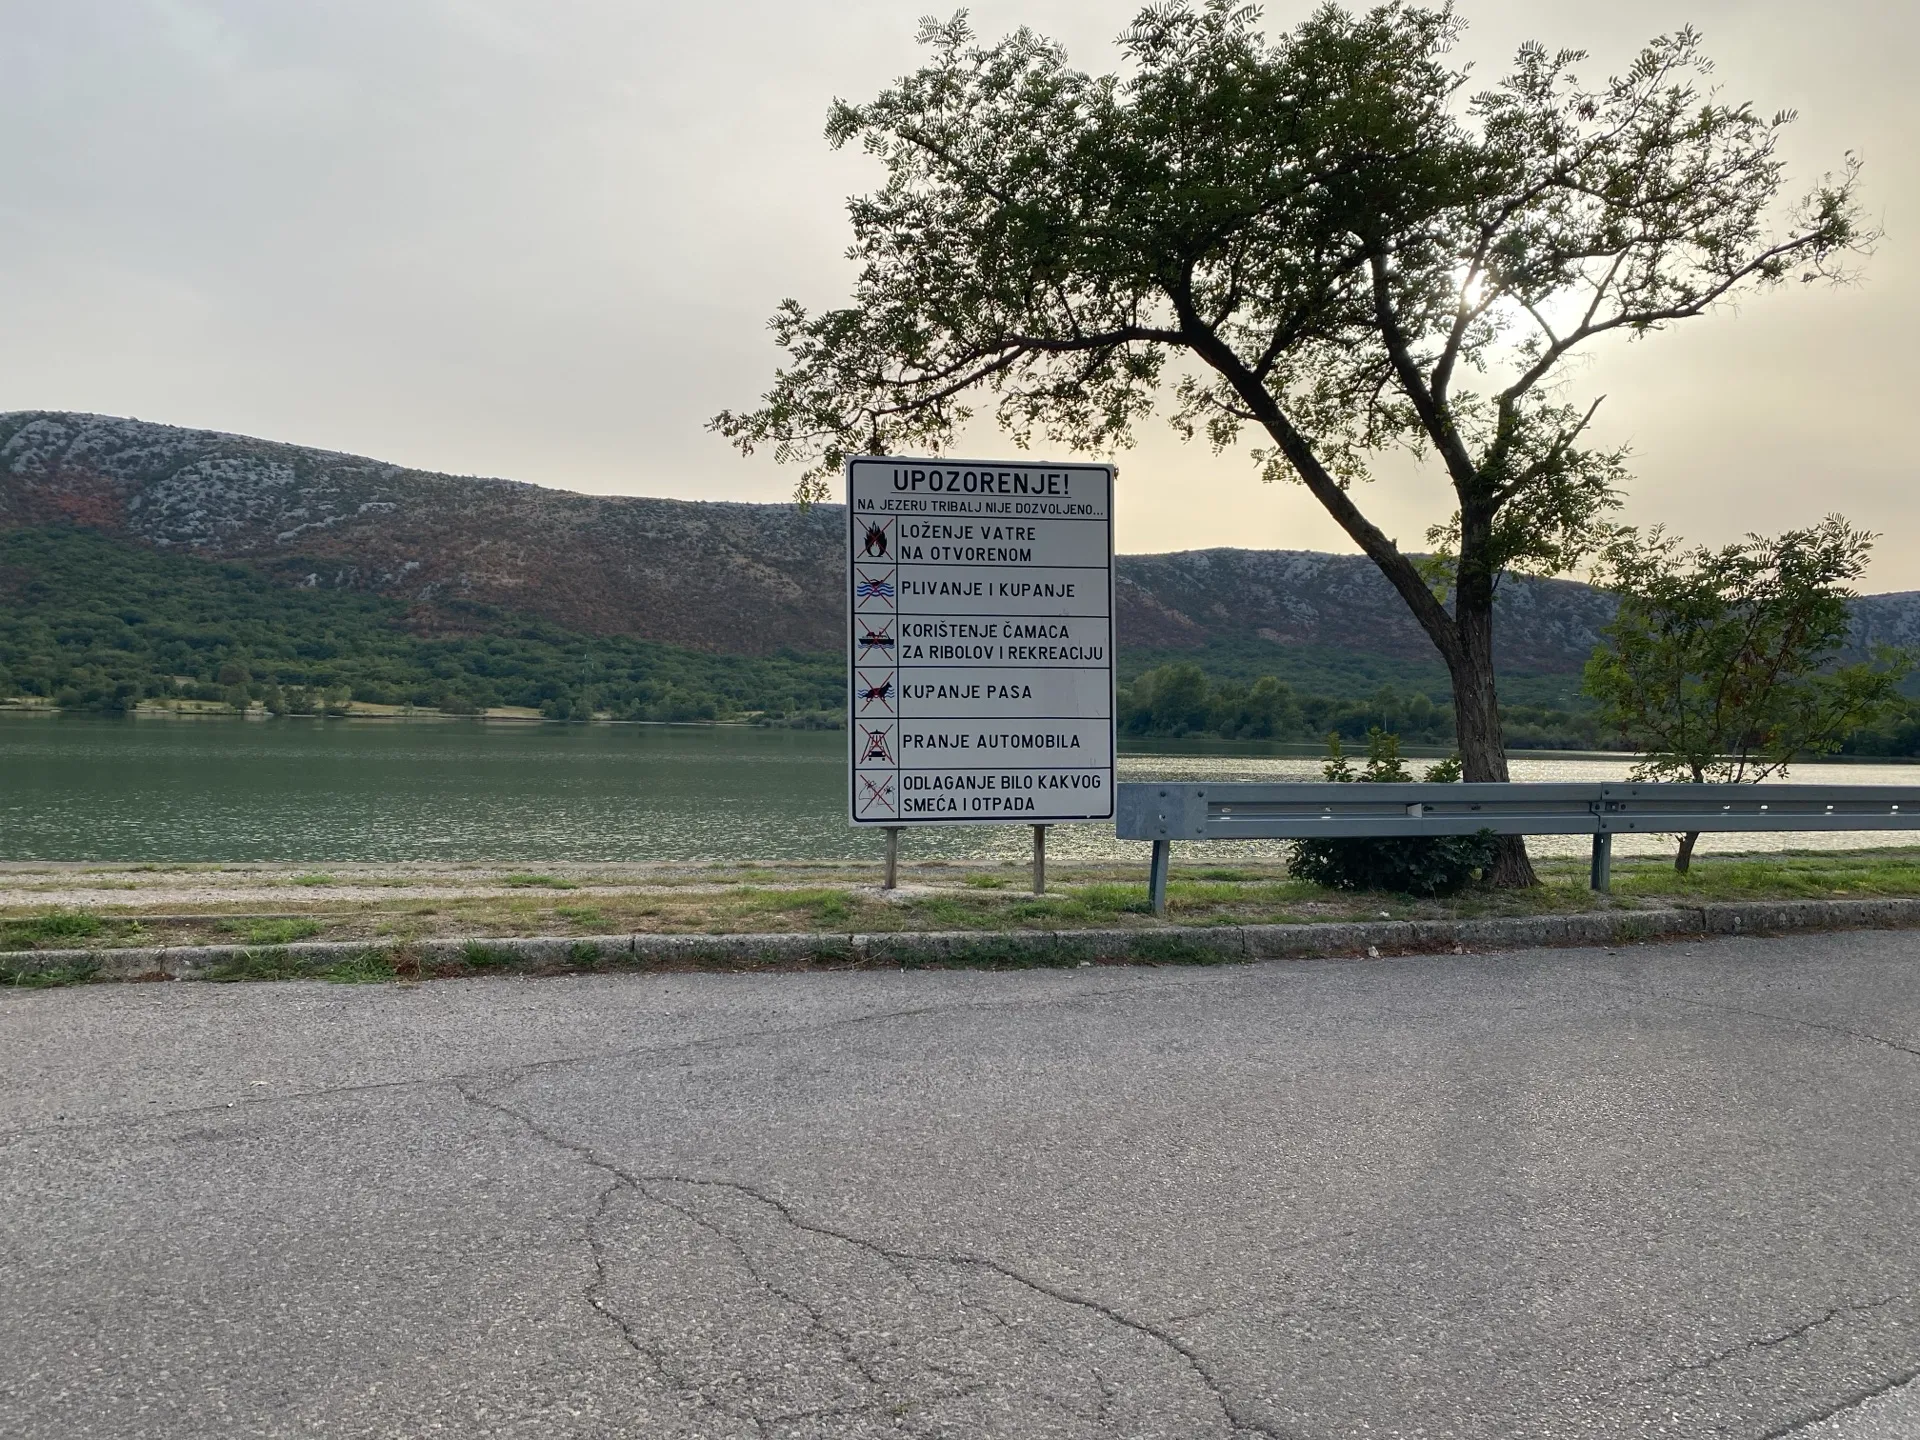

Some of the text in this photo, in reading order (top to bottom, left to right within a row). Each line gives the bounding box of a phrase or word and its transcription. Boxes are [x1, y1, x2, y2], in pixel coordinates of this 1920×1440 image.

[893, 469, 1069, 495] UPOZORENJE!
[857, 498, 1104, 515] NA JEZERU TRIBALJ NIJE DOZVOLJENO...
[901, 521, 1036, 540] LOŽENJE VATRE
[901, 545, 1032, 562] NA OTVORENOM
[901, 581, 1075, 597] PLIVANJE I KUPANJE
[902, 620, 1069, 639] KORIŠTENJE ČAMACA
[902, 645, 1103, 660] ZA RIBOLOV I REKREACIJU
[902, 684, 1032, 699] KUPANJE PASA
[903, 734, 1081, 749] PRANJE AUTOMOBILA
[903, 774, 1101, 790] ODLAGANJE BILO KAKVOG
[903, 794, 1035, 812] SMEĆA I OTPADA
